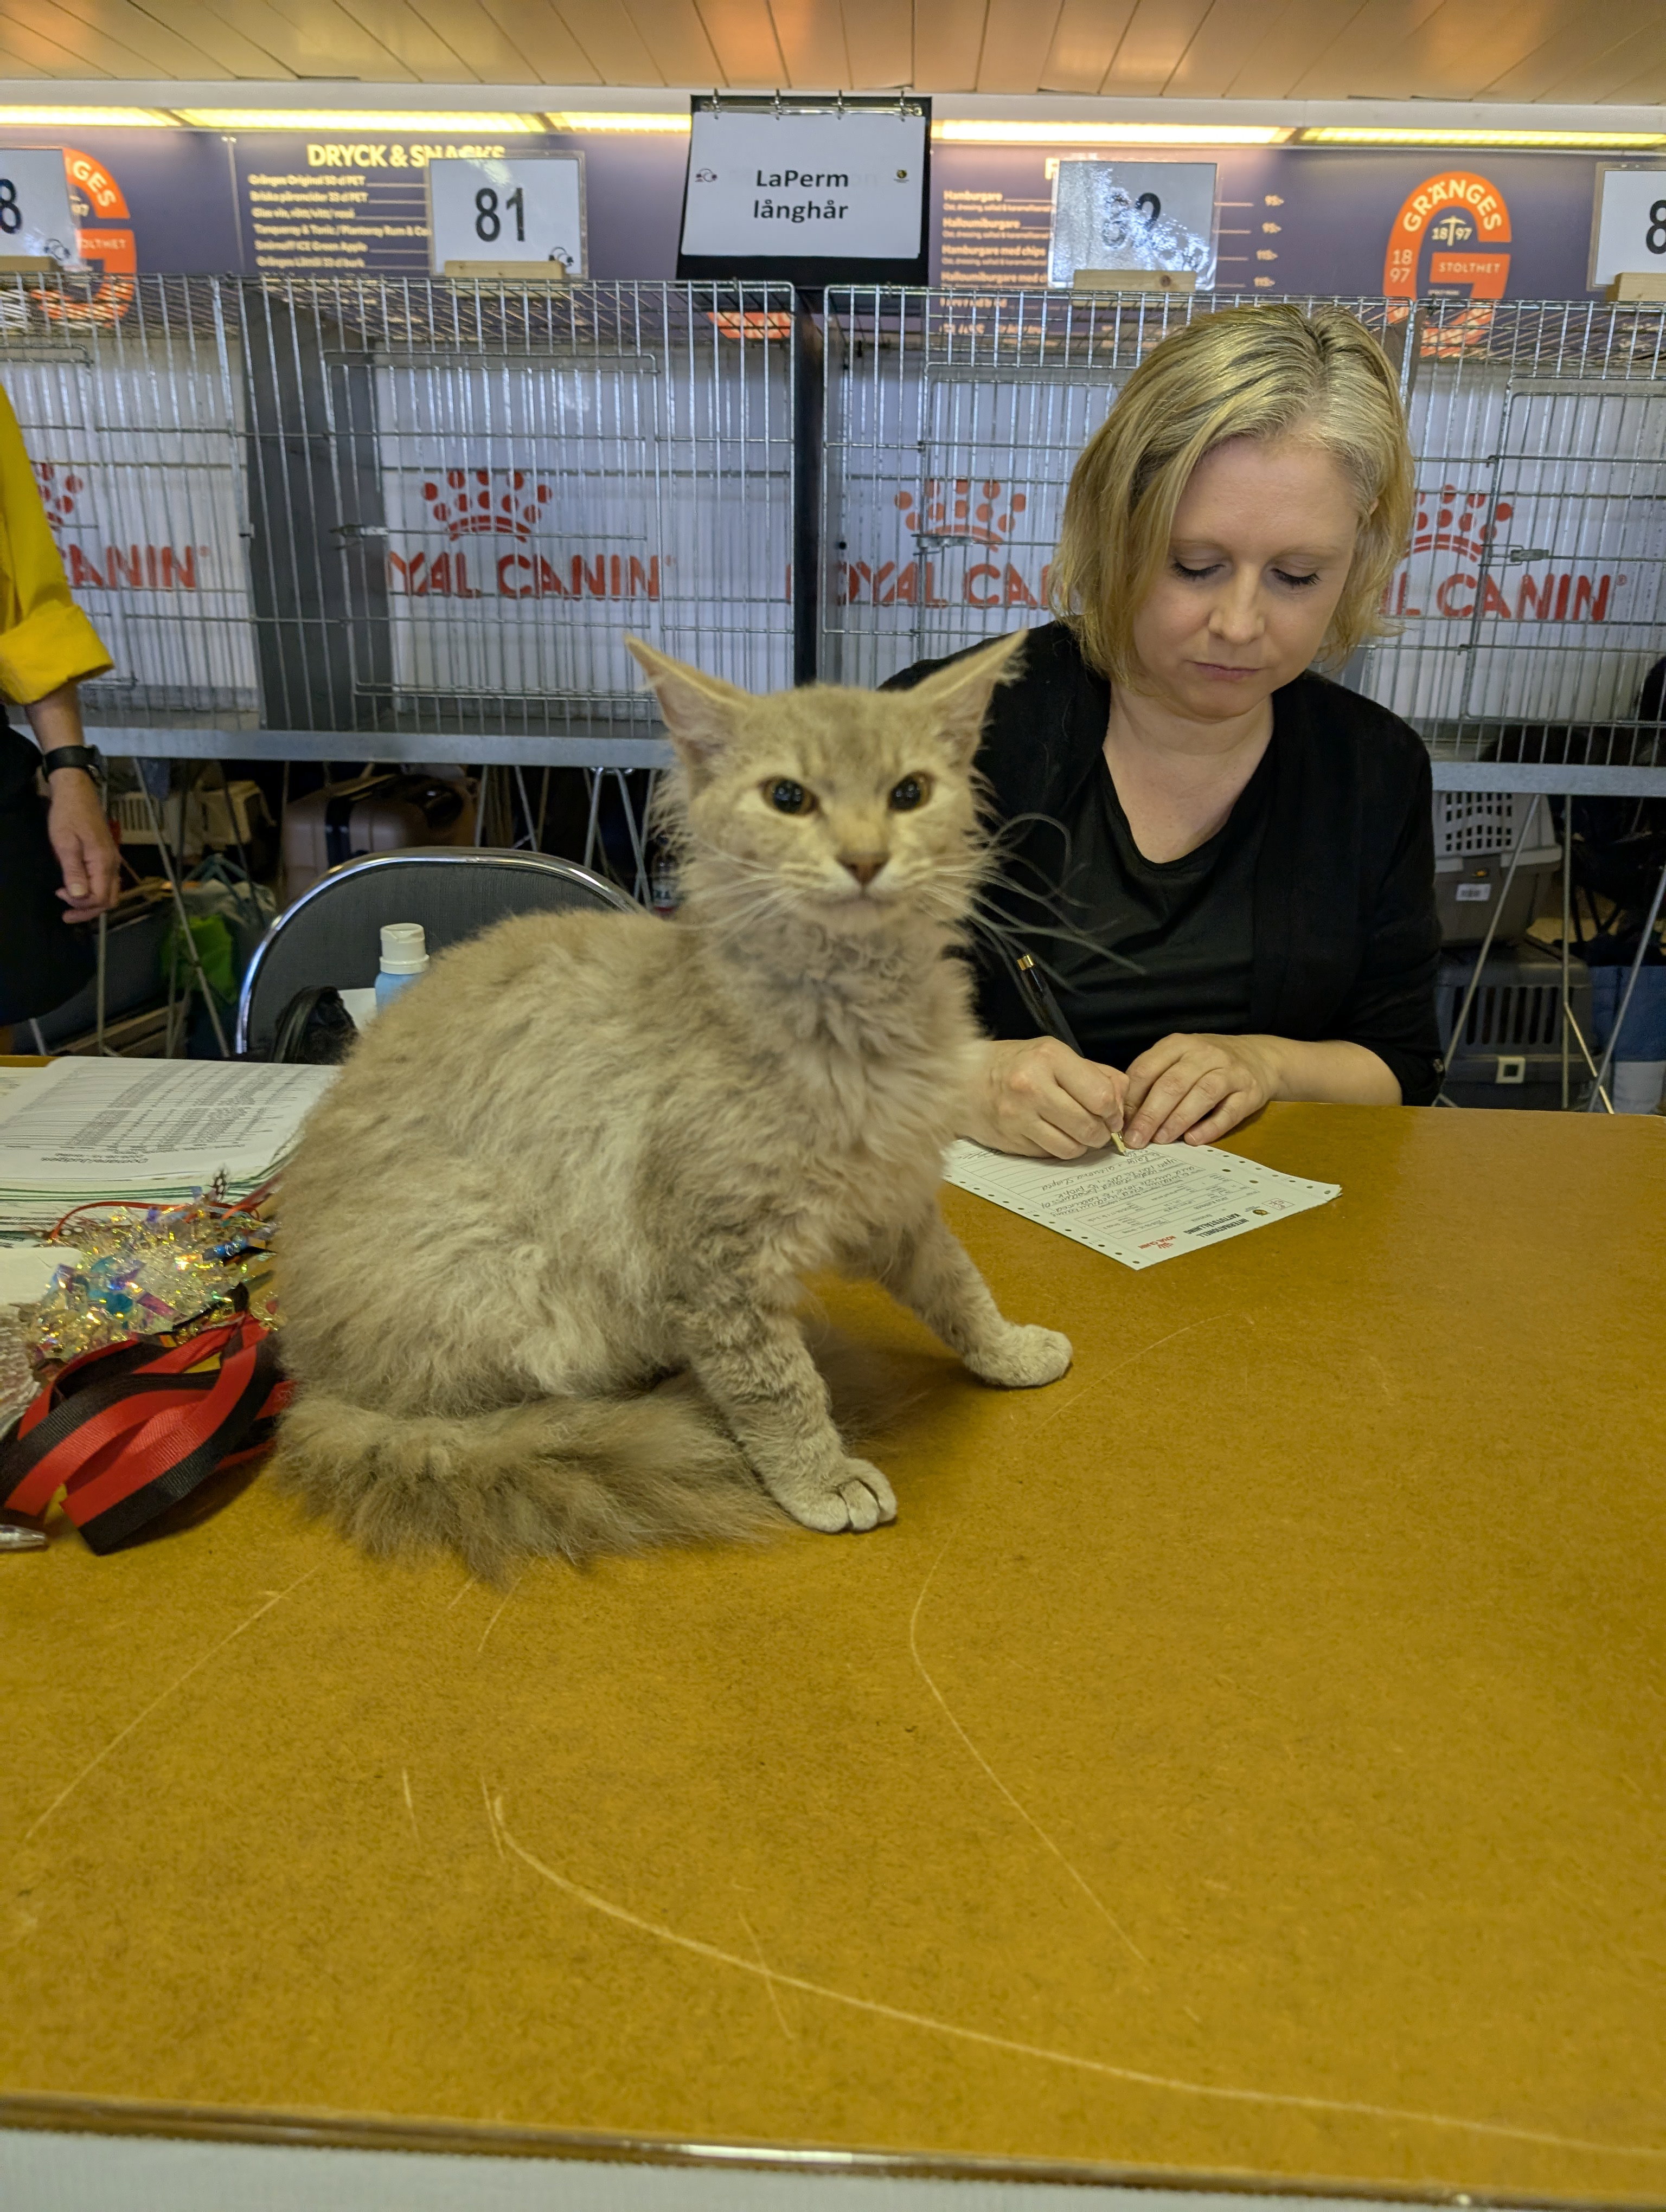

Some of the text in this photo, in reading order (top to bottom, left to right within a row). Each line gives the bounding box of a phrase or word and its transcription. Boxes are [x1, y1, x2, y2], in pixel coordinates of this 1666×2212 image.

[307, 144, 388, 167] DRYCK
[390, 144, 408, 167] &
[756, 169, 849, 188] LaPerm
[475, 188, 525, 242] 81
[753, 199, 849, 223] långhår
[1402, 178, 1502, 232] GRÄNGES
[1393, 249, 1413, 265] 18
[1439, 262, 1501, 274] STOLTHET
[1389, 267, 1411, 283] 97
[57, 544, 196, 589] ANIN
[497, 554, 661, 602] CANIN
[1436, 573, 1611, 622] CANIN
[1184, 1213, 1239, 1234] KATTUTSTÄLLNING
[1197, 1219, 1247, 1237] INTERNATIONELL
